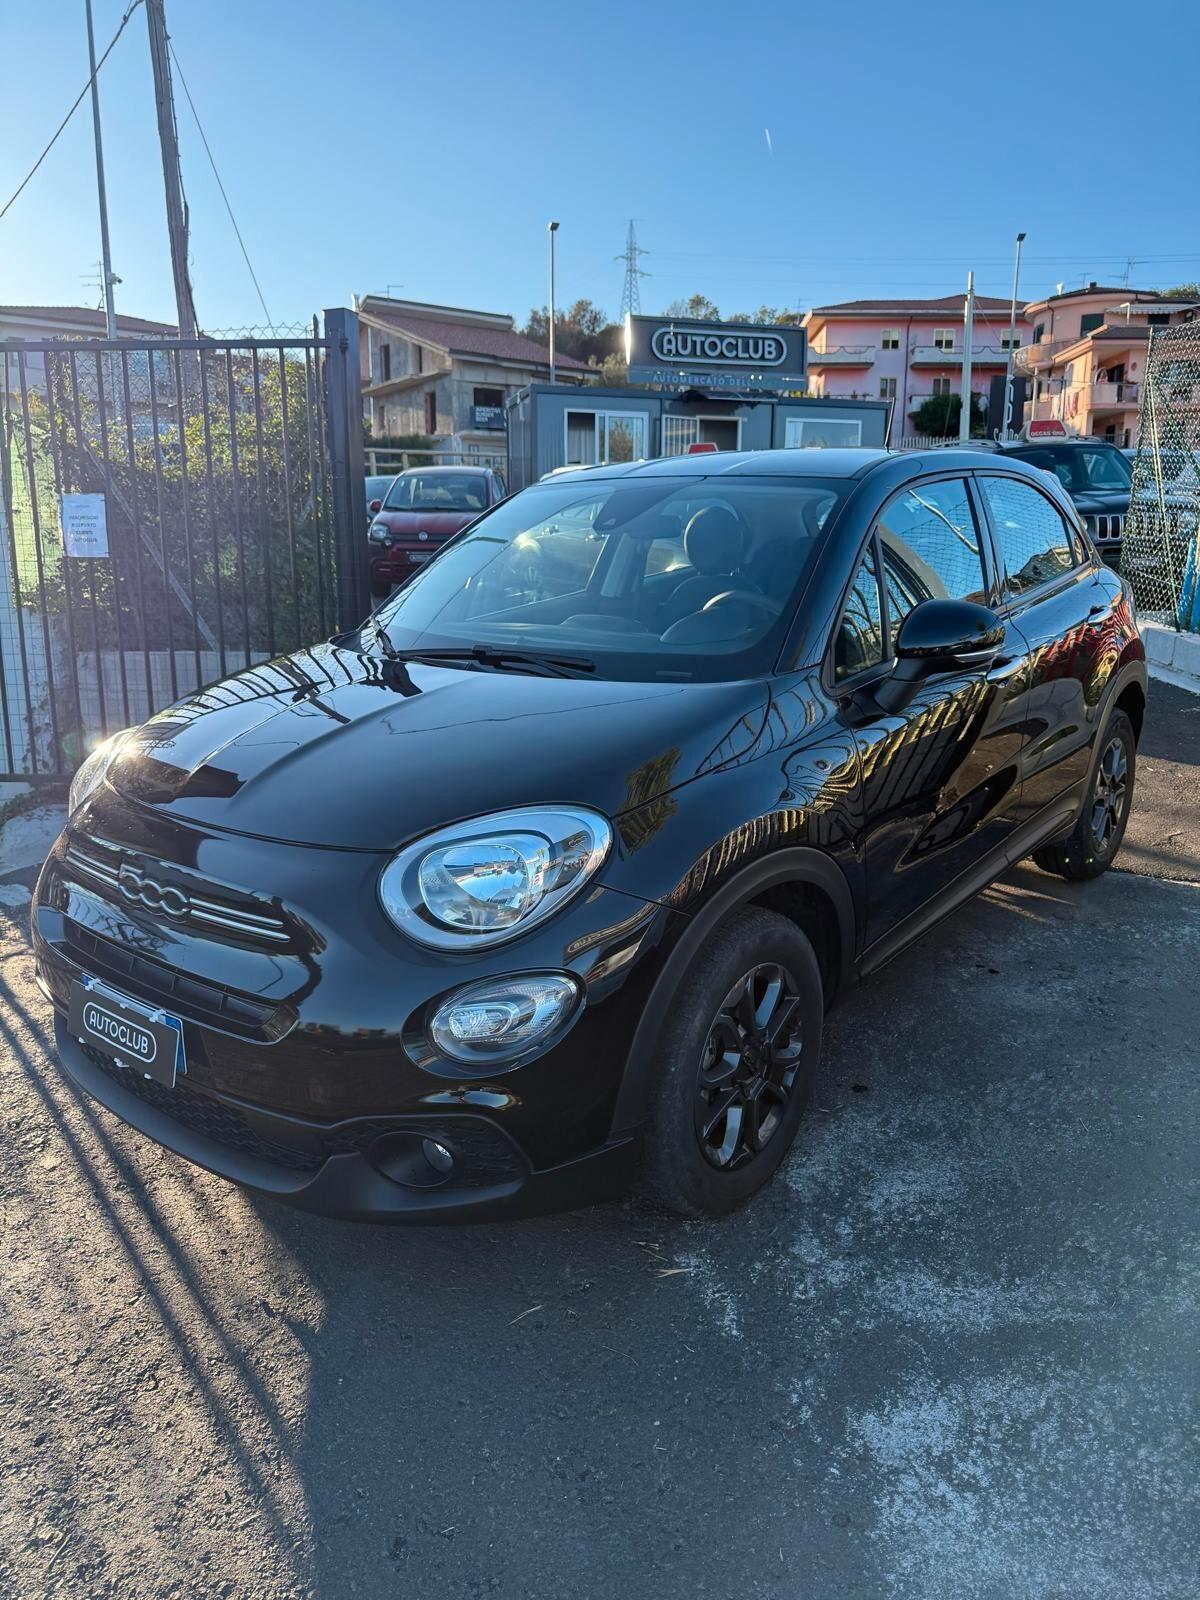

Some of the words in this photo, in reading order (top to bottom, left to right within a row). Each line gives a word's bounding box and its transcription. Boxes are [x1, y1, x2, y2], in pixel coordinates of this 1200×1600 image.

[662, 334, 777, 360] AUTOCLUB
[652, 374, 726, 386] AUTOMERCATO
[118, 863, 191, 917] 500
[89, 1010, 149, 1054] AUTOCLUB
